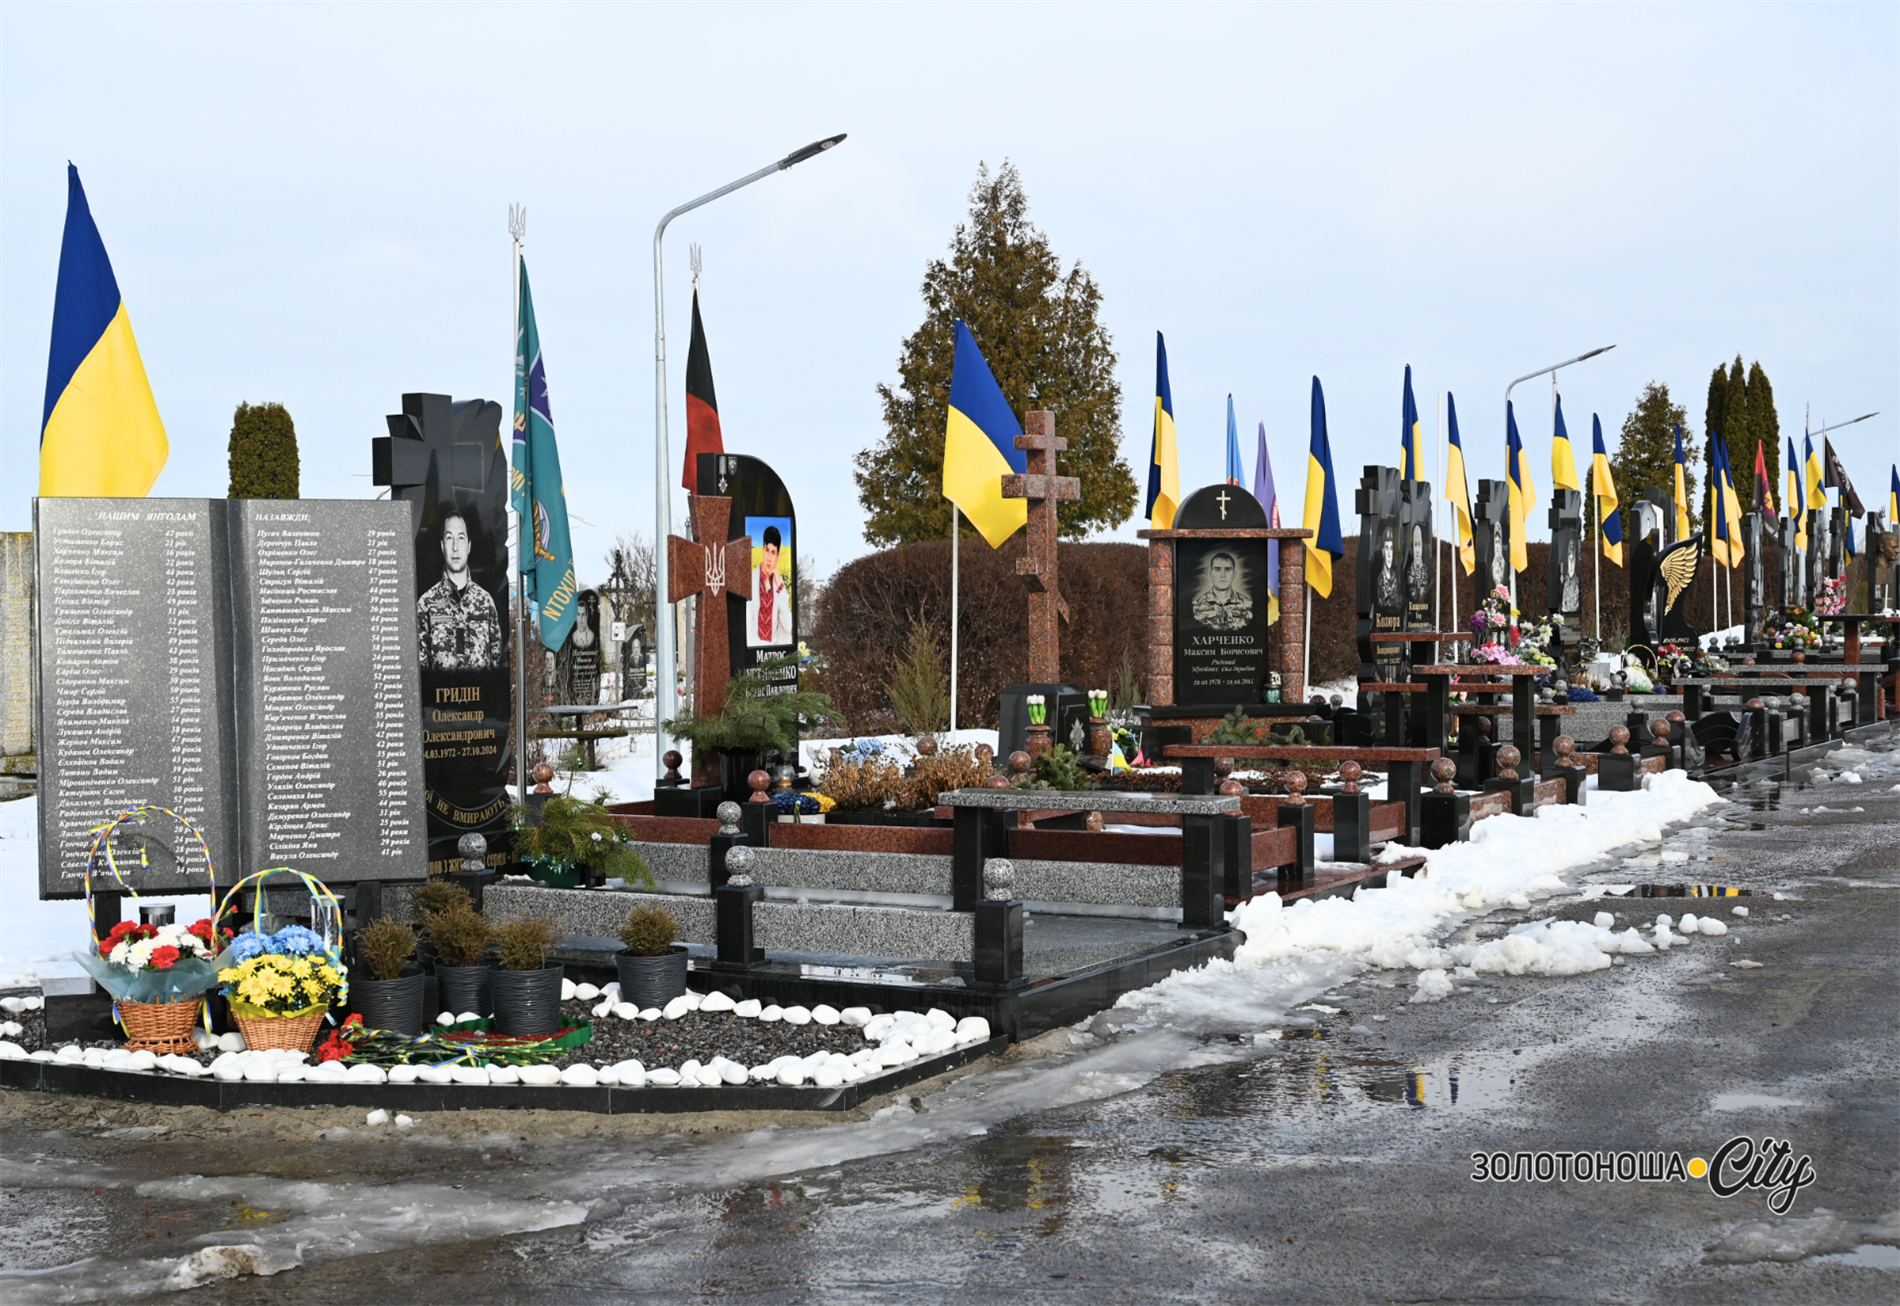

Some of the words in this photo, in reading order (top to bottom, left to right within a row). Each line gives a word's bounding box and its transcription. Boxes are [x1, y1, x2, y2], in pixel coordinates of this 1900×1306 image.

[97, 512, 140, 520] НАШИМ
[146, 513, 196, 521] ЯНГОЛАМ
[1192, 635, 1255, 646] ХАРЧЕНКО
[304, 684, 330, 692] Руслан
[383, 683, 402, 691] років
[435, 686, 481, 705] ГРИДІН
[57, 698, 80, 706] Бурда
[82, 698, 126, 706] Володимир
[57, 708, 84, 716] Середа
[432, 709, 484, 724] Олександр
[94, 728, 122, 736] Андрій
[423, 729, 496, 743] Олександрович
[264, 734, 310, 742] Дмитренко
[312, 743, 327, 751] Ігор
[93, 748, 134, 756] Олександр
[424, 748, 457, 759] 4.03.1972
[462, 745, 497, 756] 27.10.2024
[268, 793, 305, 801] Соломаха
[103, 798, 147, 806] Володимир
[436, 799, 450, 815] НЕ
[269, 833, 307, 841] Марченко
[308, 832, 341, 840] Дмитро
[270, 853, 296, 861] Вакула
